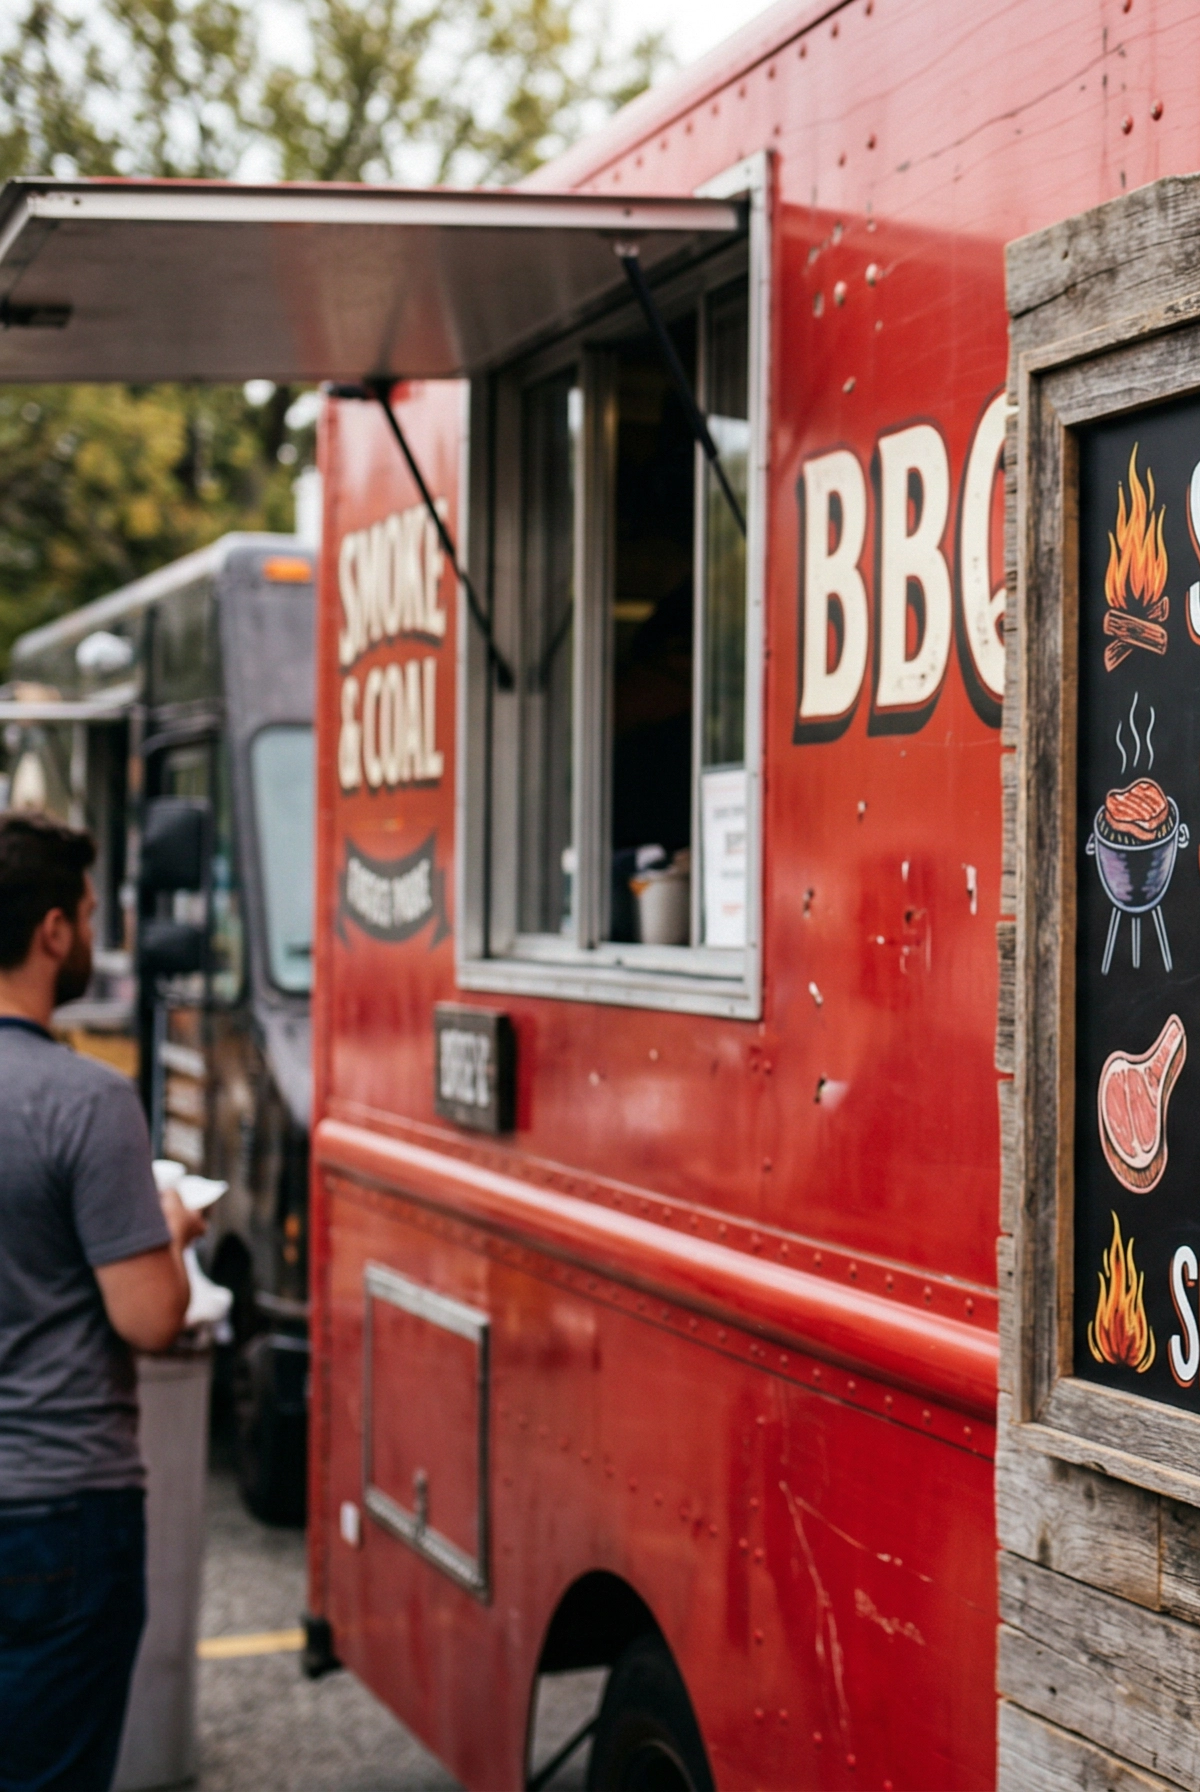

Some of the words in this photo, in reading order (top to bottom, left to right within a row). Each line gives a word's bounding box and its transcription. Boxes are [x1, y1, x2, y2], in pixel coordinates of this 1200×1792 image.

[338, 496, 448, 667] SMOKE
[338, 676, 363, 789] &
[363, 656, 444, 788] COAL
